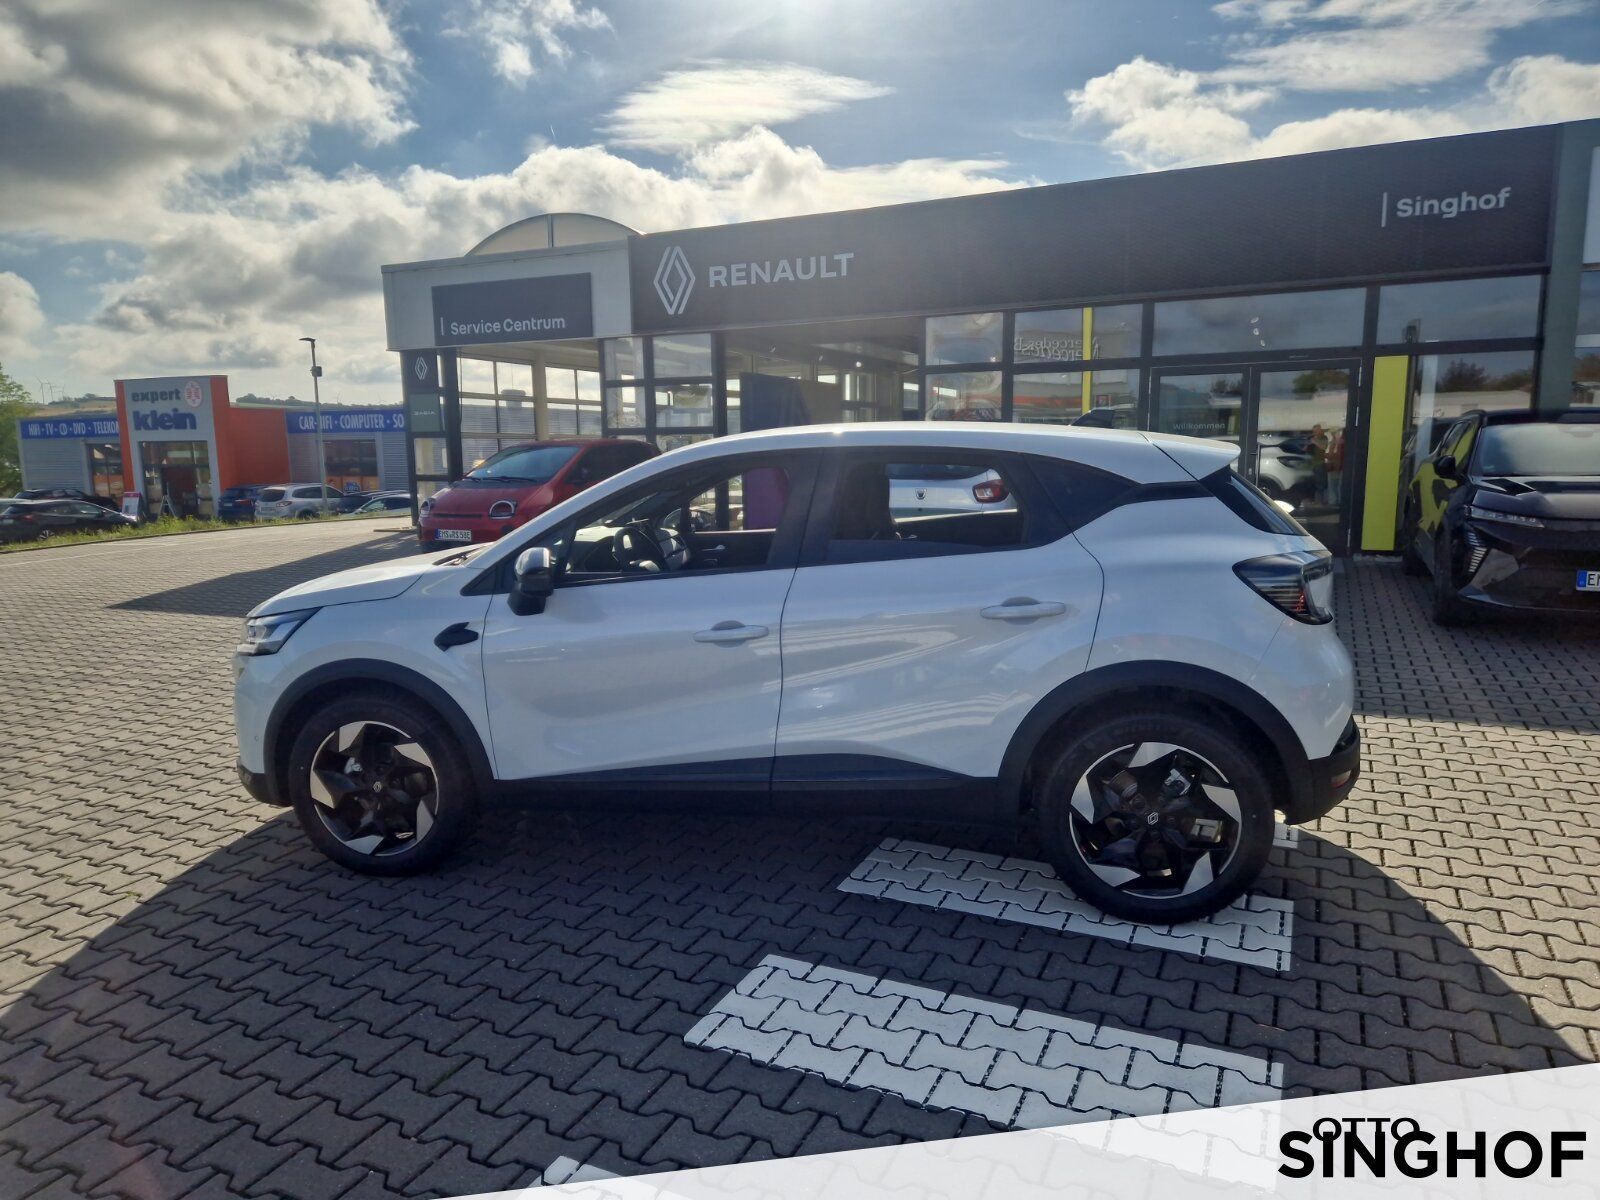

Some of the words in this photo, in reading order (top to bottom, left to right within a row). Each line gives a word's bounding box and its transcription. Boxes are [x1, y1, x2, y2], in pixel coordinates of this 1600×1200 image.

[1396, 187, 1512, 219] Singhof
[709, 252, 855, 288] RENAULT
[450, 319, 501, 336] Service
[503, 317, 566, 333] Centrum
[131, 387, 181, 404] expert
[45, 423, 54, 435] TV
[73, 422, 86, 434] DVD
[132, 408, 197, 431] klein
[340, 414, 385, 429] COMPUTER
